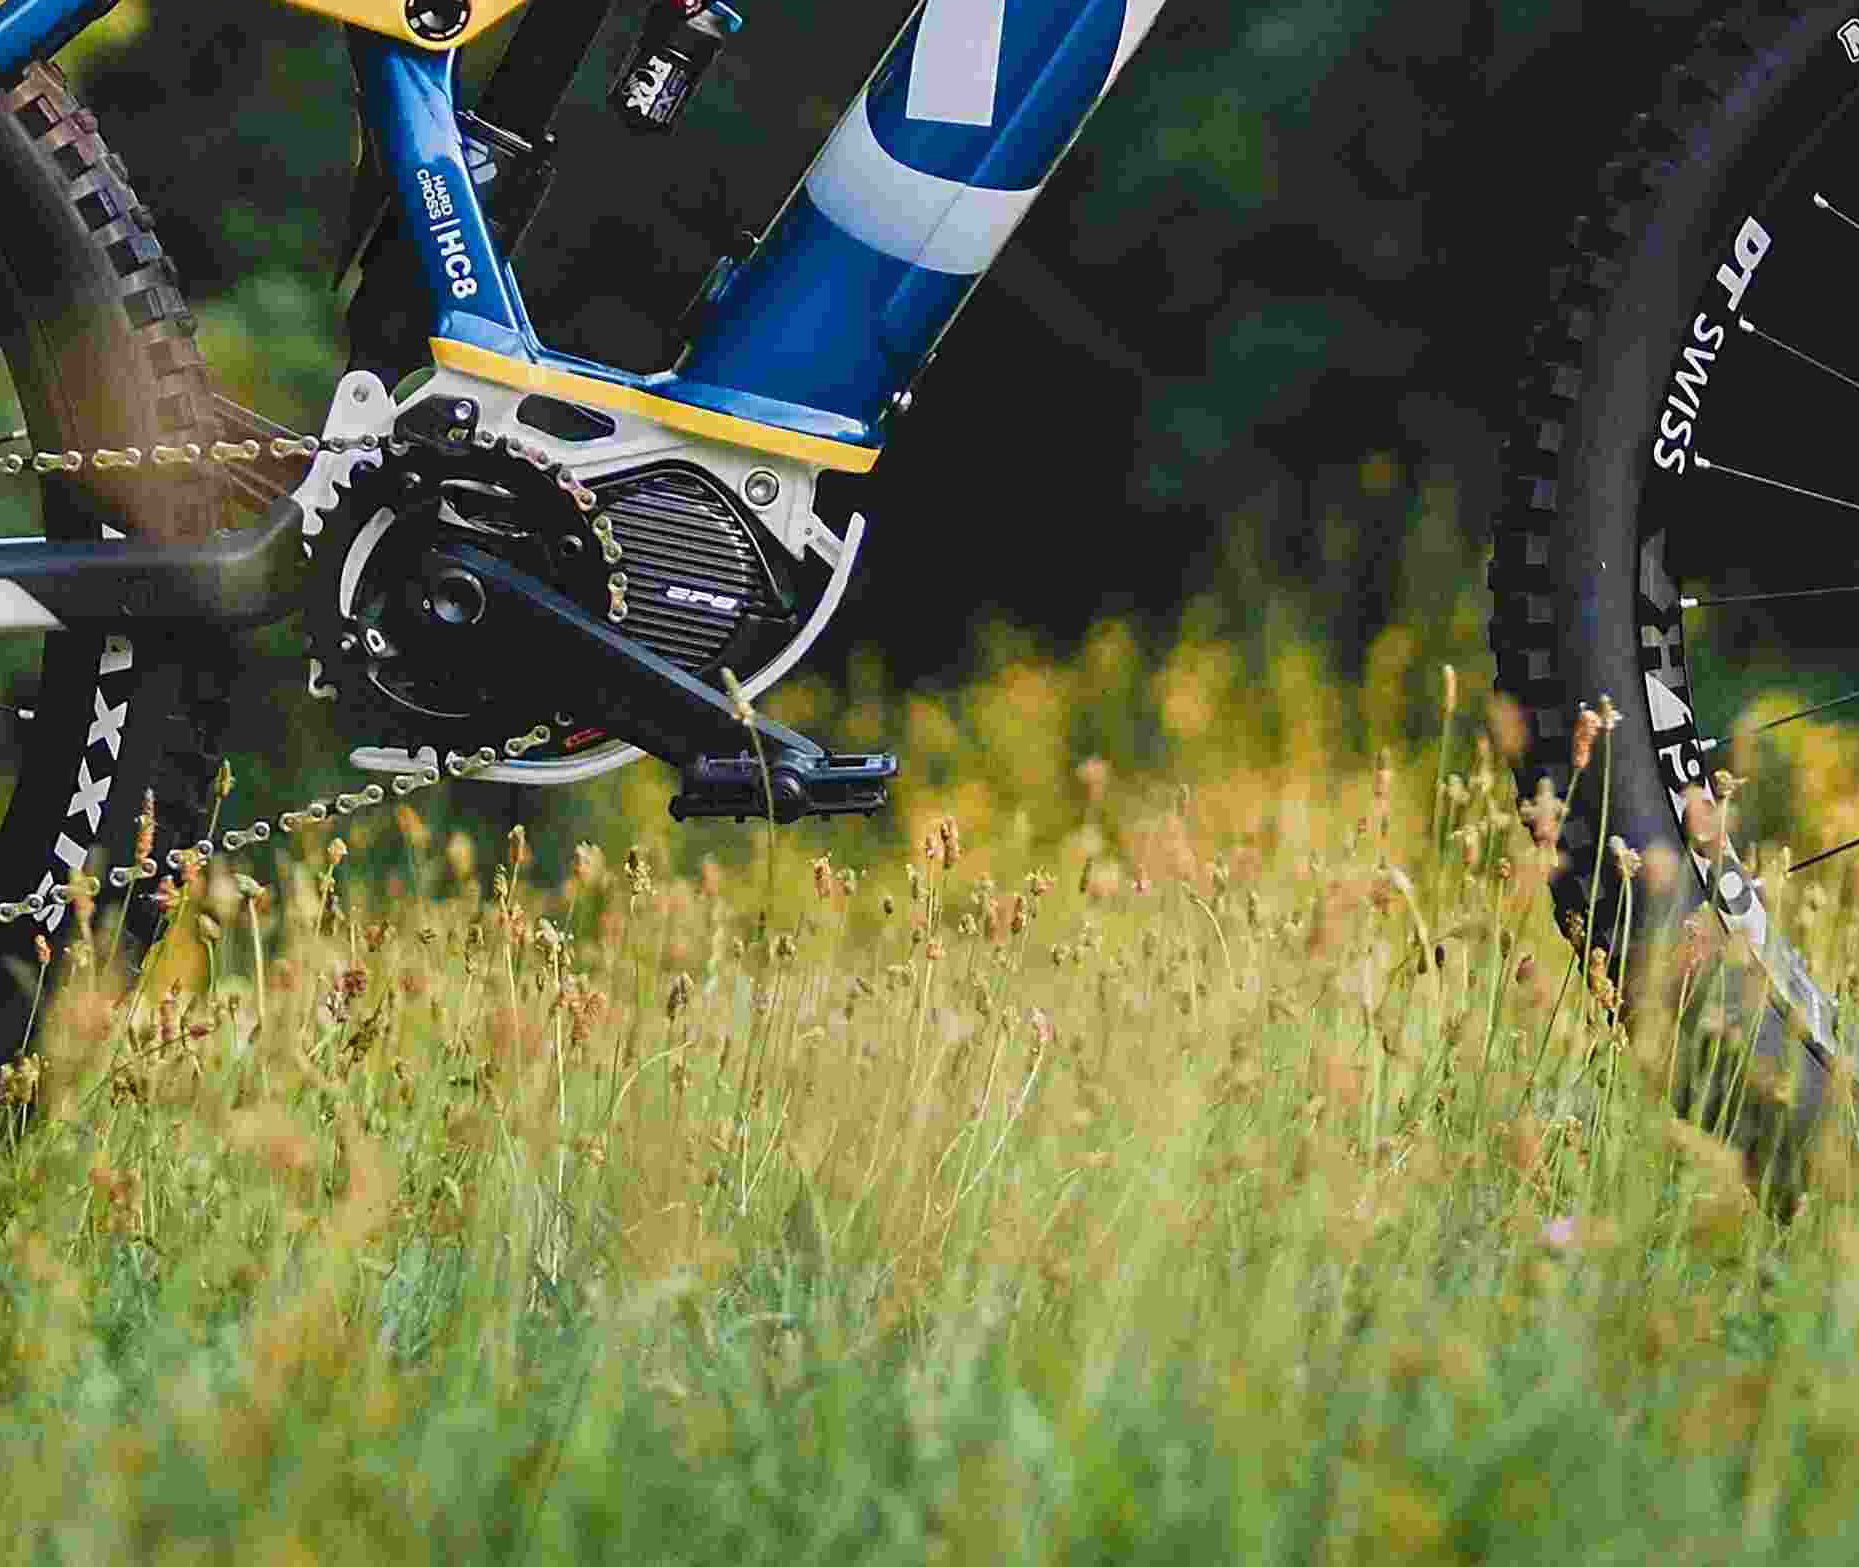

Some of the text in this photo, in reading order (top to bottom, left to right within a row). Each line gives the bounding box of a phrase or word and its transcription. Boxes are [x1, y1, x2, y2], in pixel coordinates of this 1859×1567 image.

[622, 55, 673, 116] FOX
[416, 168, 442, 220] CROSS
[432, 174, 454, 217] HARD
[437, 230, 478, 299] HC8
[1653, 216, 1772, 474] DT SWISS
